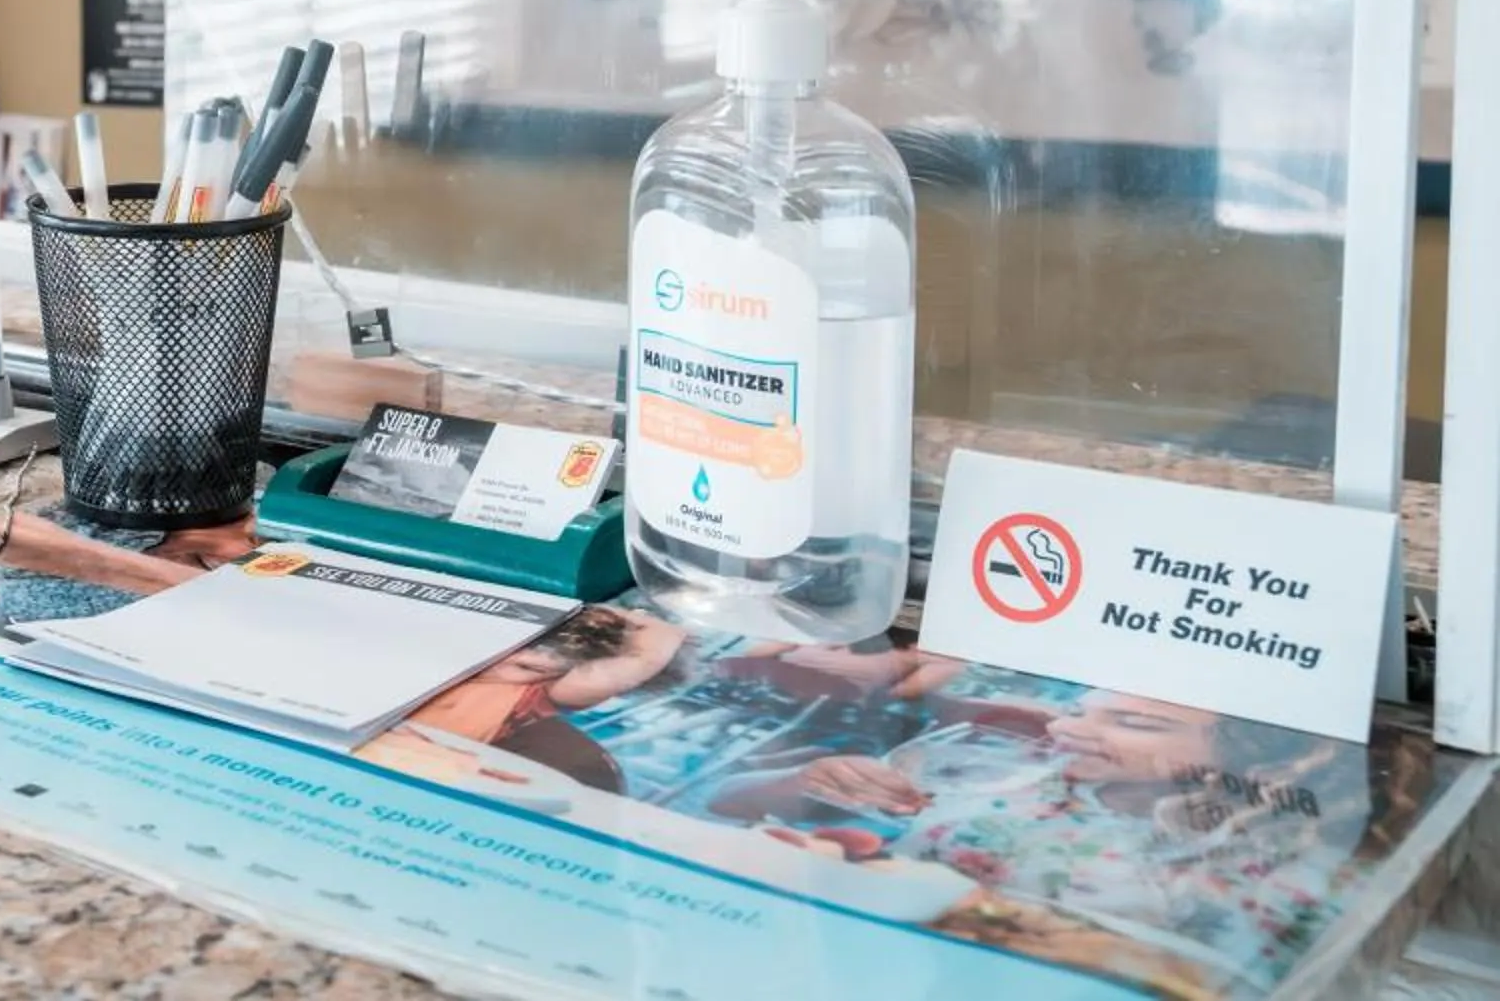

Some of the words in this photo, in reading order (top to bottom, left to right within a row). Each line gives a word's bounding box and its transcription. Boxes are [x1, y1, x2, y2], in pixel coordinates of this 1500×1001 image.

[643, 348, 683, 374] HAND
[685, 361, 784, 395] SANITIZER
[669, 379, 744, 406] ADVANCED
[378, 408, 431, 438] SUPER
[427, 417, 442, 440] 8
[387, 438, 461, 467] JACKSON
[679, 503, 724, 524] Original
[306, 565, 348, 582] SEE
[348, 570, 385, 589] YOU
[385, 577, 415, 594] ON
[414, 581, 453, 603] THE
[450, 591, 509, 614] ROAD
[1131, 547, 1236, 587] Thank
[1248, 567, 1310, 600] You
[1184, 588, 1243, 618] For
[1100, 601, 1162, 634] Not
[1169, 615, 1322, 670] Smoking
[22, 698, 121, 733] points
[118, 725, 176, 750] into
[177, 744, 199, 757] a
[201, 752, 329, 798] moment
[326, 791, 363, 809] to
[364, 803, 452, 836] spoil
[451, 829, 616, 886] someone
